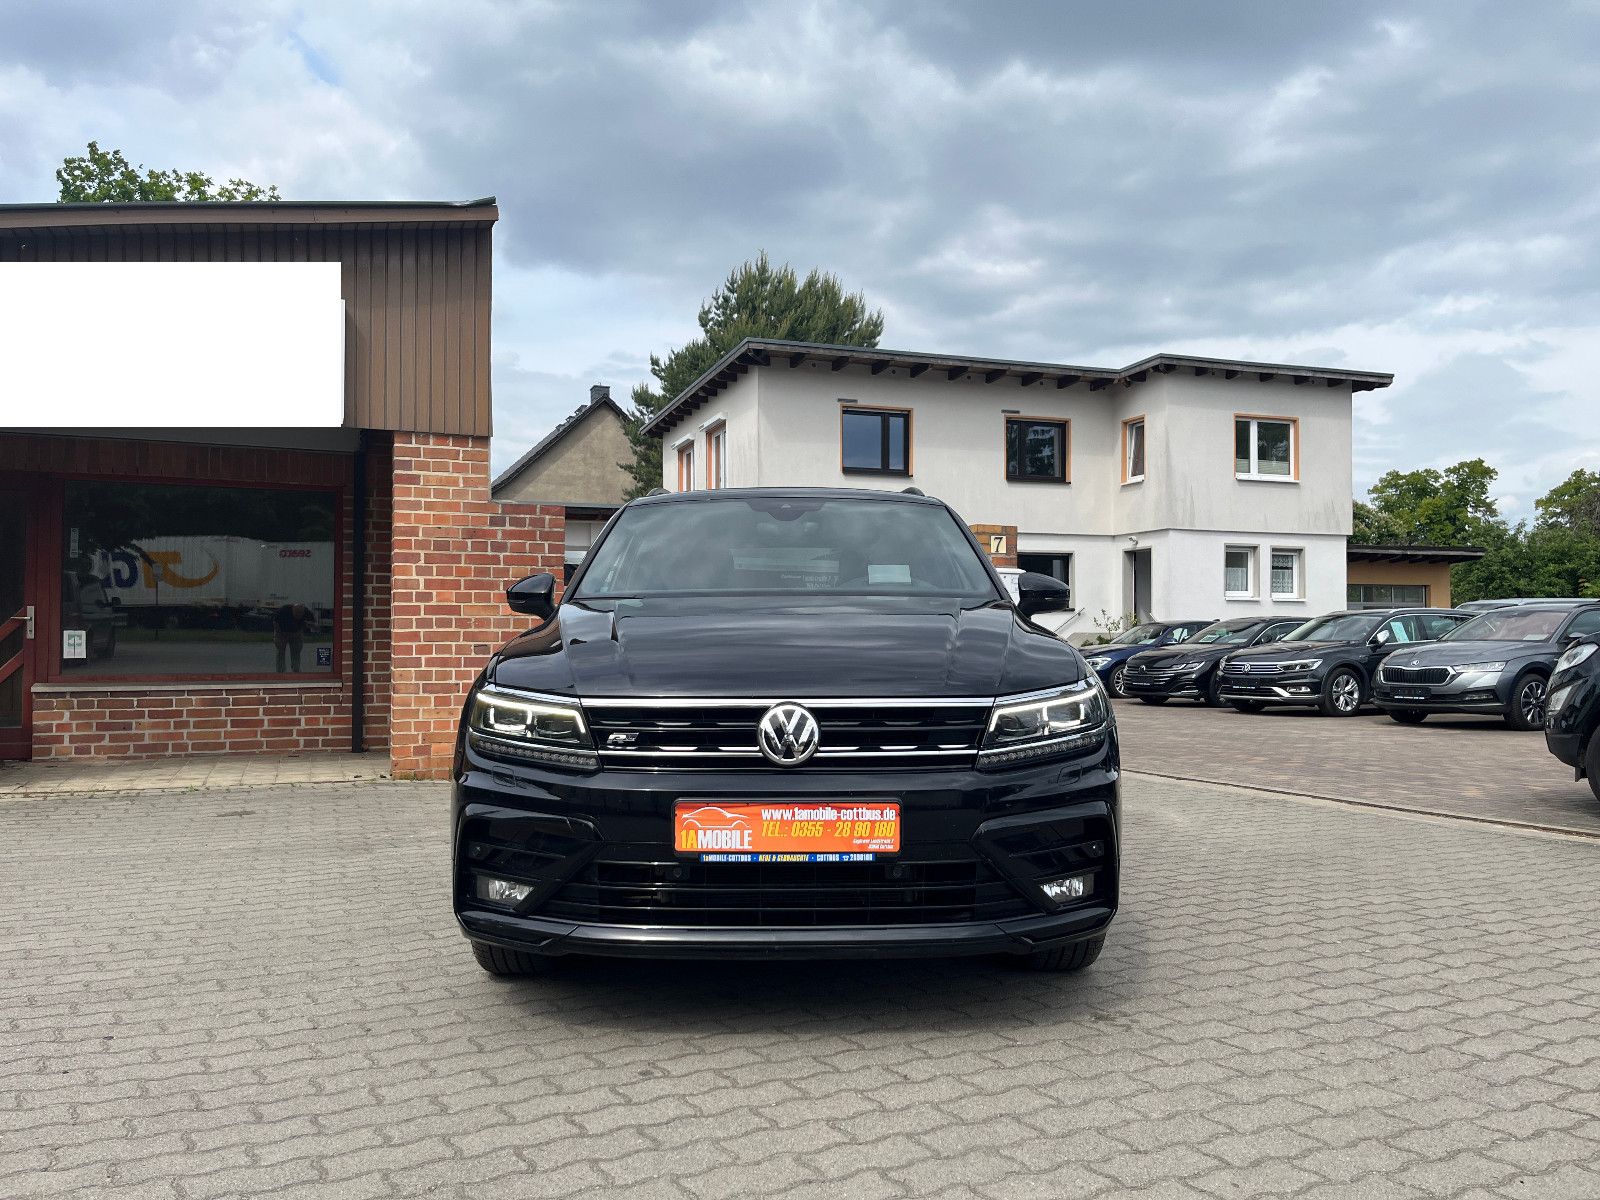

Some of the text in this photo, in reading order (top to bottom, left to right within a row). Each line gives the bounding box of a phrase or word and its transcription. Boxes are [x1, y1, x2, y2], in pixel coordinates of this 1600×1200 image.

[993, 536, 1004, 553] 7
[761, 806, 896, 821] www.1amobile-cottbus.de
[790, 821, 824, 837] 0355
[834, 821, 851, 837] 28
[853, 821, 871, 837] 90
[873, 821, 896, 837] 180
[681, 829, 753, 849] 1AMOBILE
